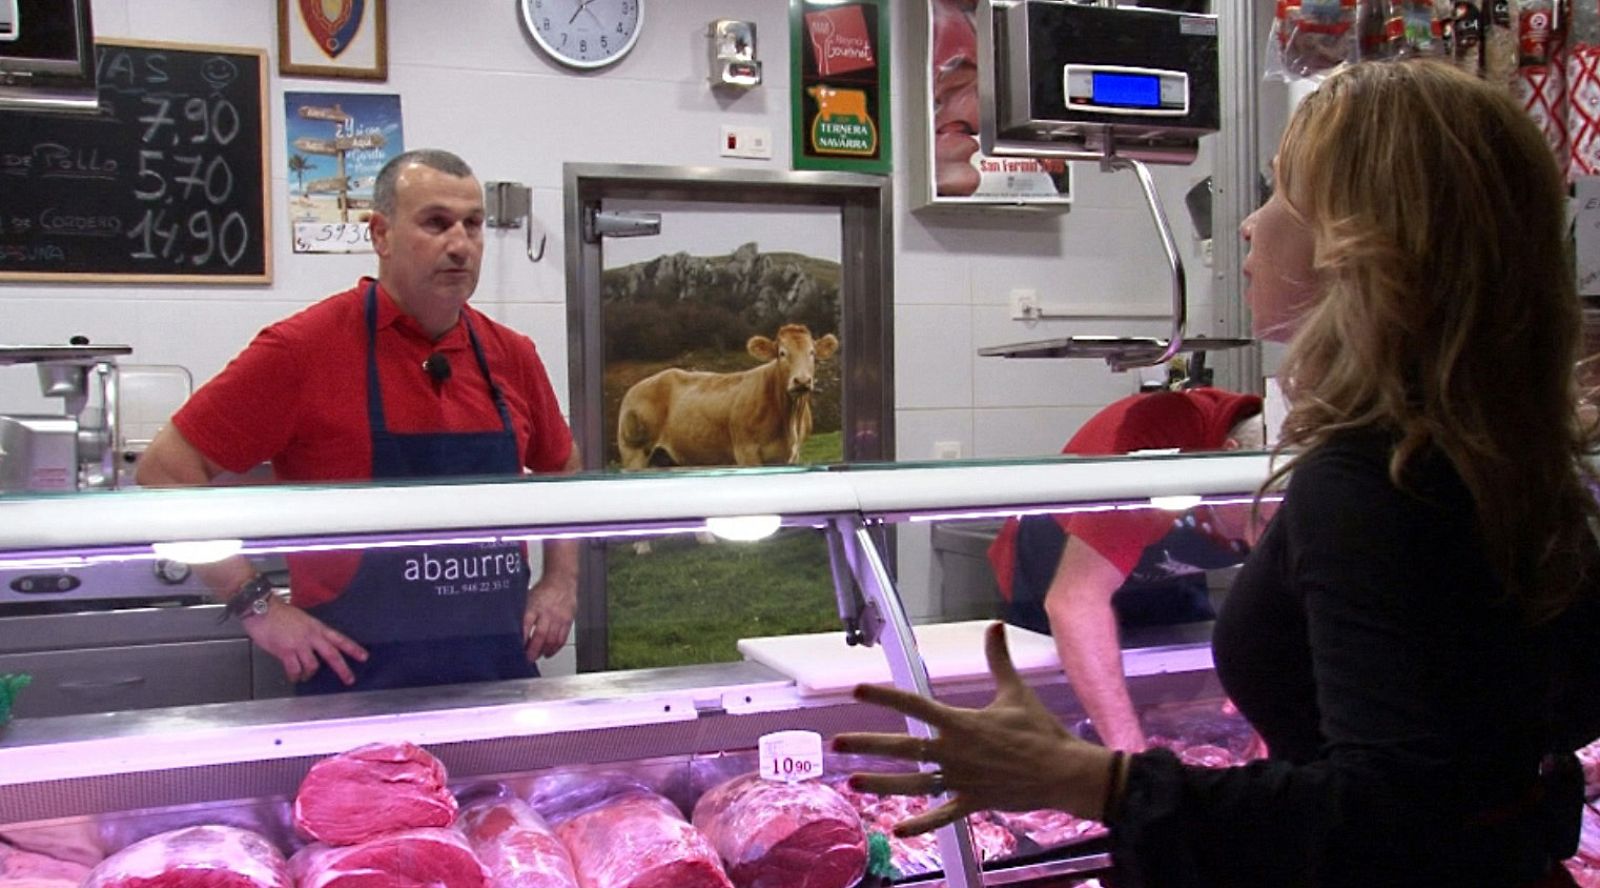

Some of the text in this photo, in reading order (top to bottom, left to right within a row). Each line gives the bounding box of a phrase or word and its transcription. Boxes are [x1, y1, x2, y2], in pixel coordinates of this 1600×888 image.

[543, 18, 550, 31] 8
[616, 22, 623, 33] 4
[561, 33, 568, 46] 7
[600, 35, 608, 48] 5
[579, 40, 587, 53] 6
[826, 40, 873, 61] Gourmet
[138, 94, 240, 146] 7,90
[821, 123, 868, 135] TERNERA
[820, 137, 868, 149] NAVARRA
[981, 159, 1000, 172] San
[134, 151, 233, 204] 5,70
[128, 209, 247, 266] 14,90
